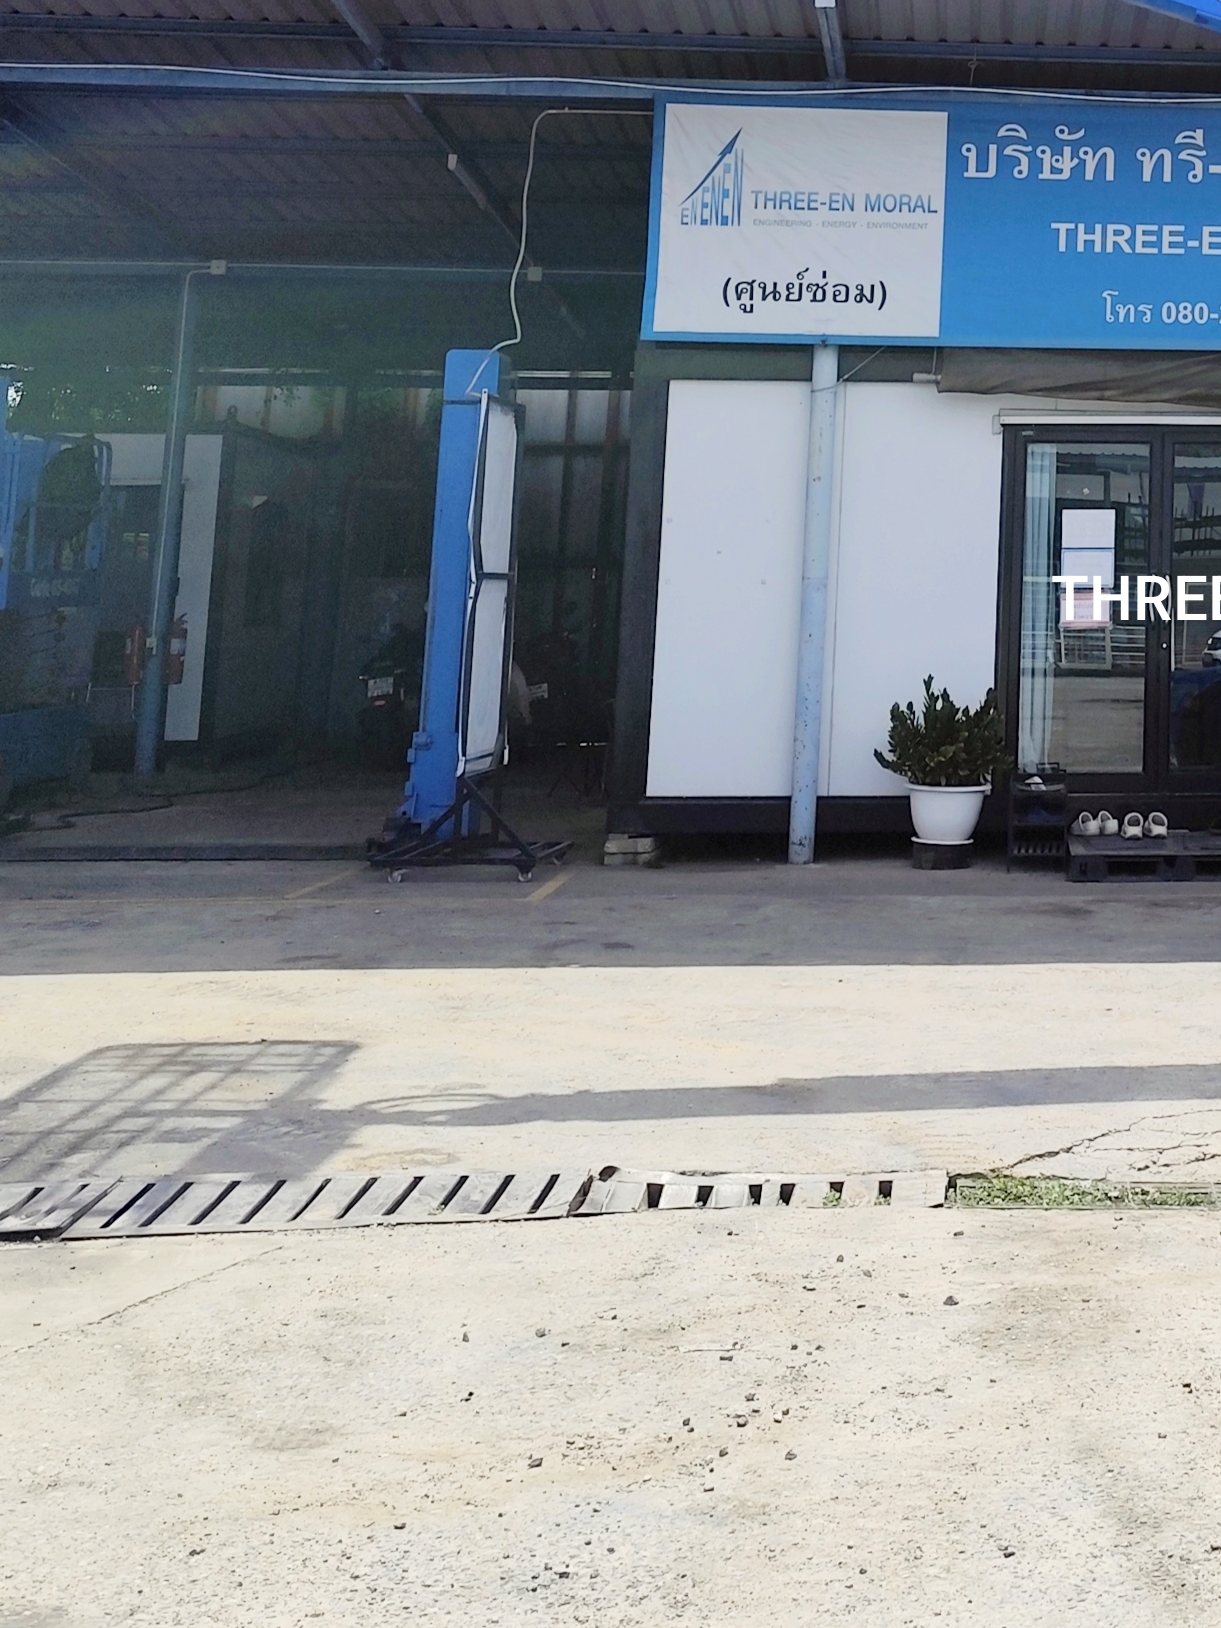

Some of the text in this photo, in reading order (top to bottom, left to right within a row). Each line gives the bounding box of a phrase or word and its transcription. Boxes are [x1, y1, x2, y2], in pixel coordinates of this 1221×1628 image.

[961, 123, 1115, 182] บริษัท
[751, 189, 938, 214] THREE-EN MORAL
[753, 218, 813, 228] ENGINEERING
[821, 220, 857, 229] ENERGY
[866, 221, 928, 230] ENVIRONMENT
[721, 267, 887, 314] (ศูนย์ซ่อม)
[1102, 291, 1152, 324] โทร
